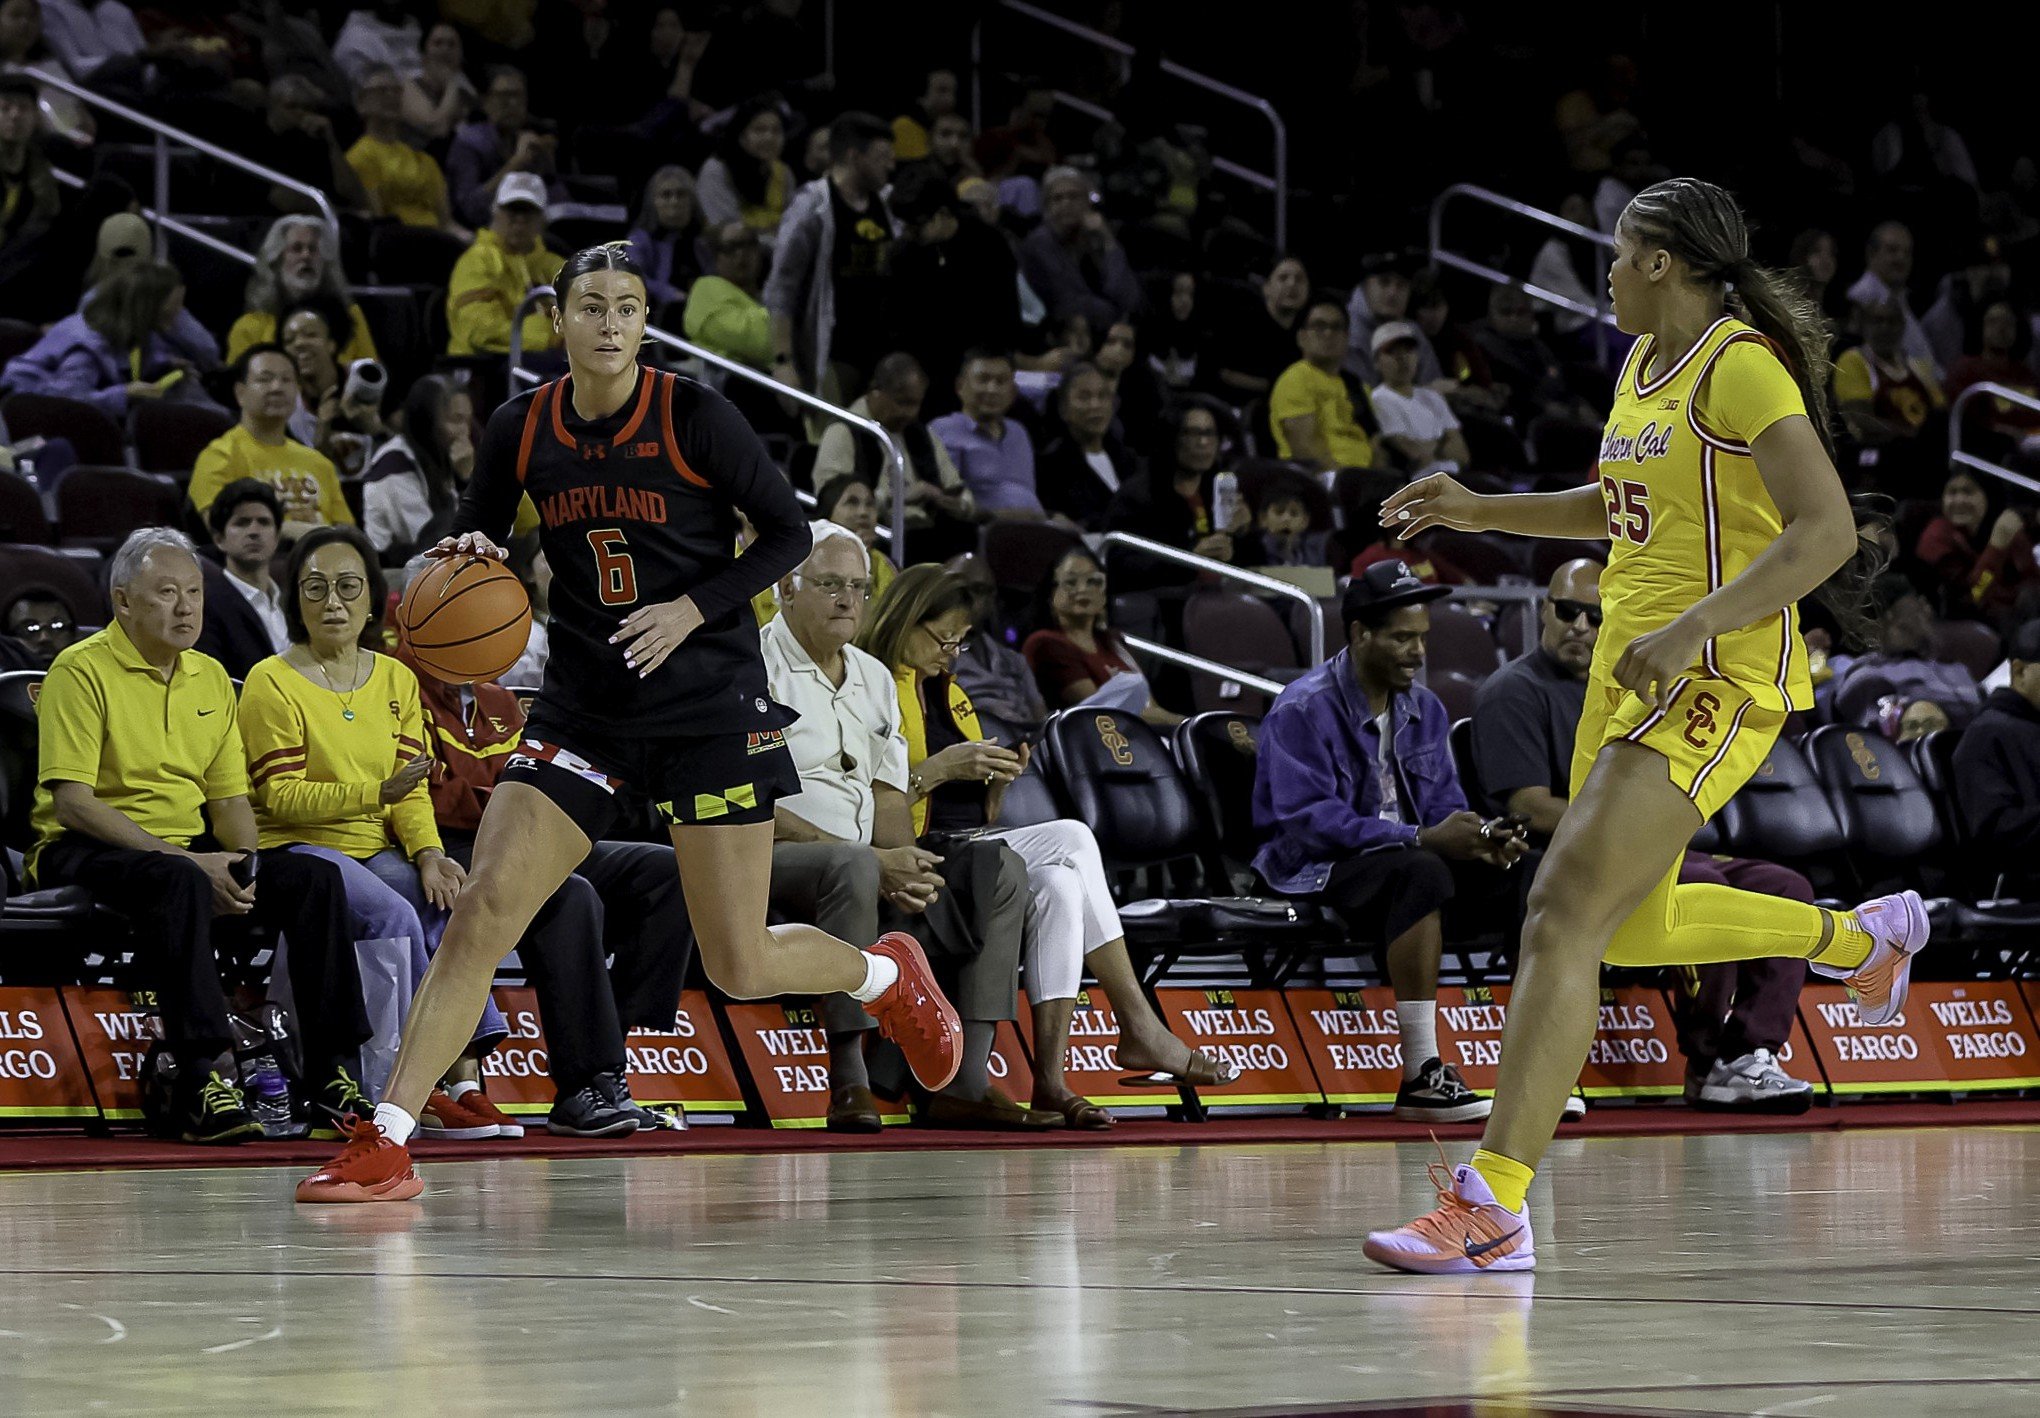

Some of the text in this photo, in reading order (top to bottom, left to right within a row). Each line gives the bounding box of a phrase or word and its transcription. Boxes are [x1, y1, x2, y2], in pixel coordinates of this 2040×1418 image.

[1635, 420, 1672, 465] Cal
[540, 485, 667, 531] MARYLAND
[1602, 475, 1651, 545] 25
[587, 528, 638, 606] 6
[1182, 1009, 1276, 1036] WELLS
[1311, 1009, 1399, 1035] WELLS
[1930, 999, 2014, 1027] WELLS
[1832, 1034, 1918, 1061] FARGO
[1946, 1031, 2026, 1059] FARGO
